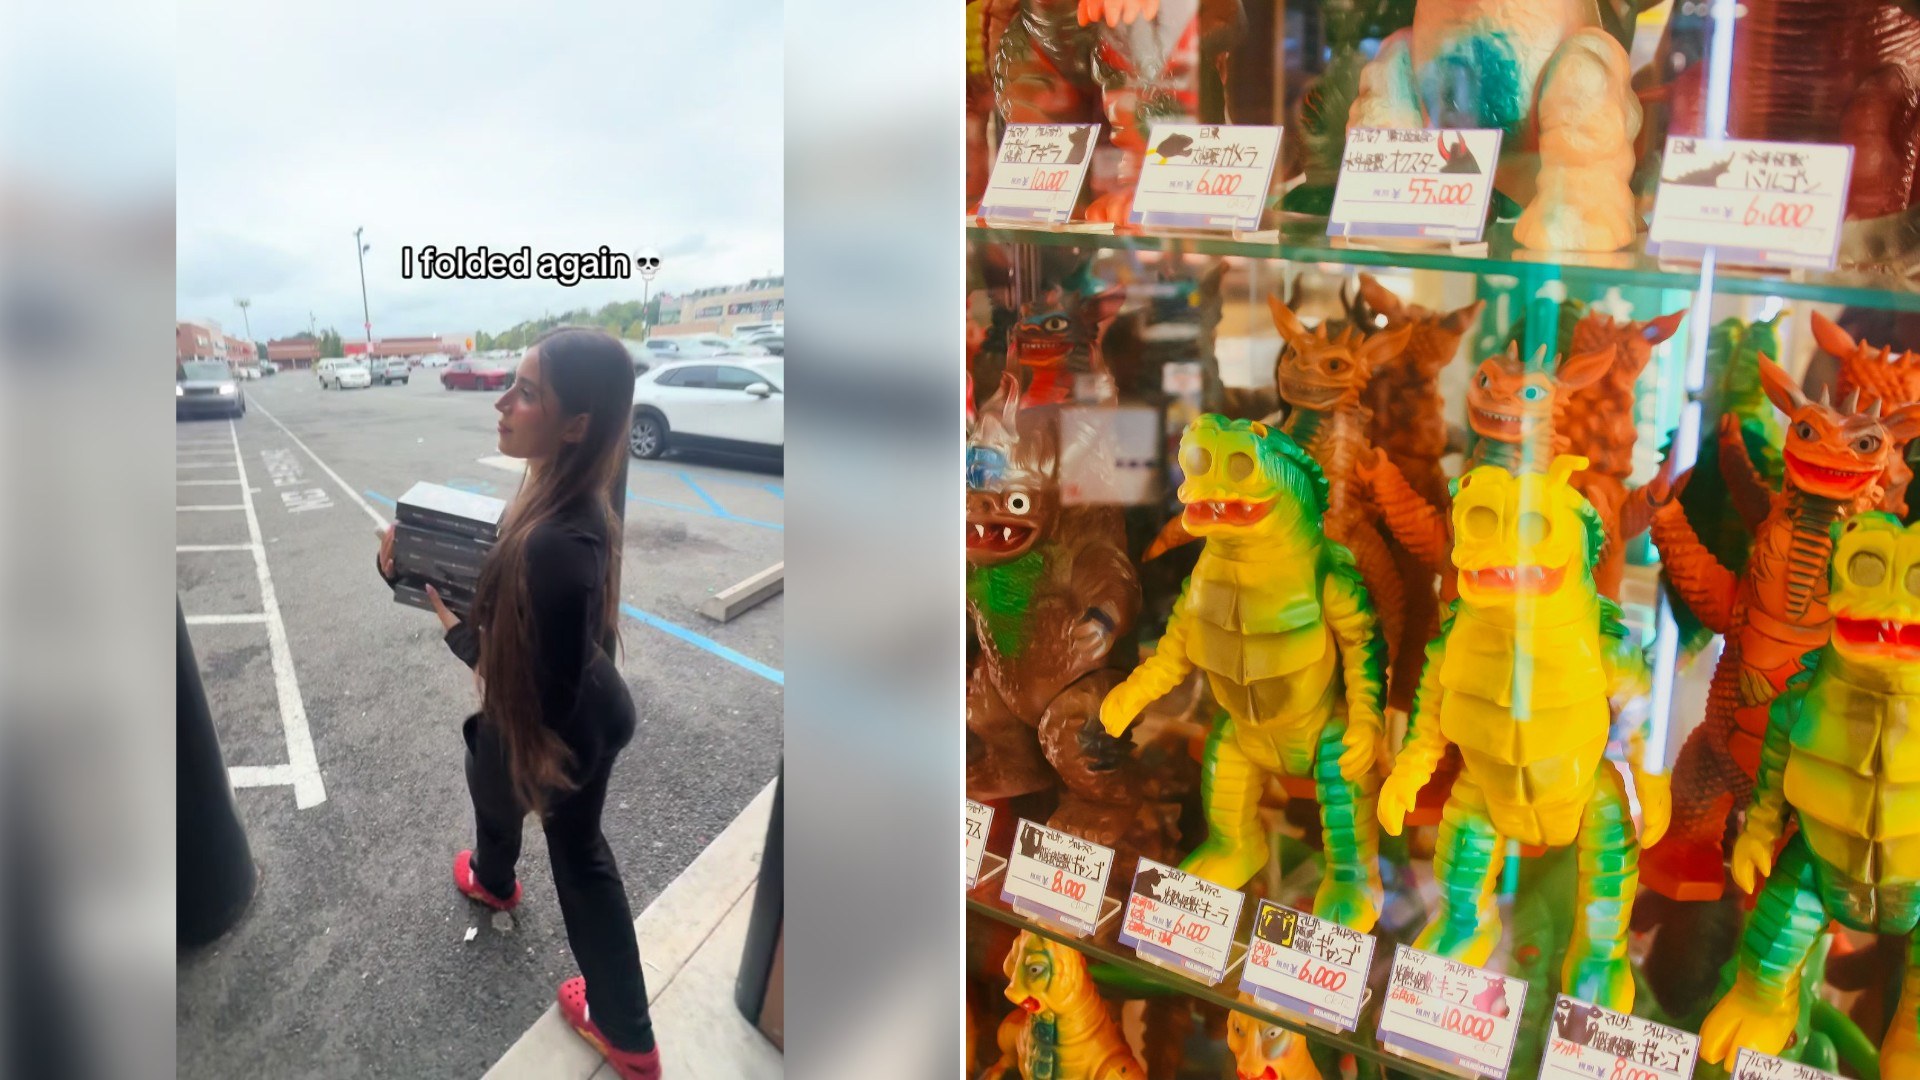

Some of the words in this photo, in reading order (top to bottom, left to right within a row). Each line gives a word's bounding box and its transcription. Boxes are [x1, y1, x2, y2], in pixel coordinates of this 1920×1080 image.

[1196, 168, 1242, 195] 6,000
[1408, 178, 1473, 205] 55,000
[1743, 195, 1814, 227] 6,000
[1052, 869, 1086, 901] 8,000
[1173, 914, 1210, 942] 6,000
[1298, 959, 1346, 991] 6,000
[1441, 1007, 1494, 1041] 10,000
